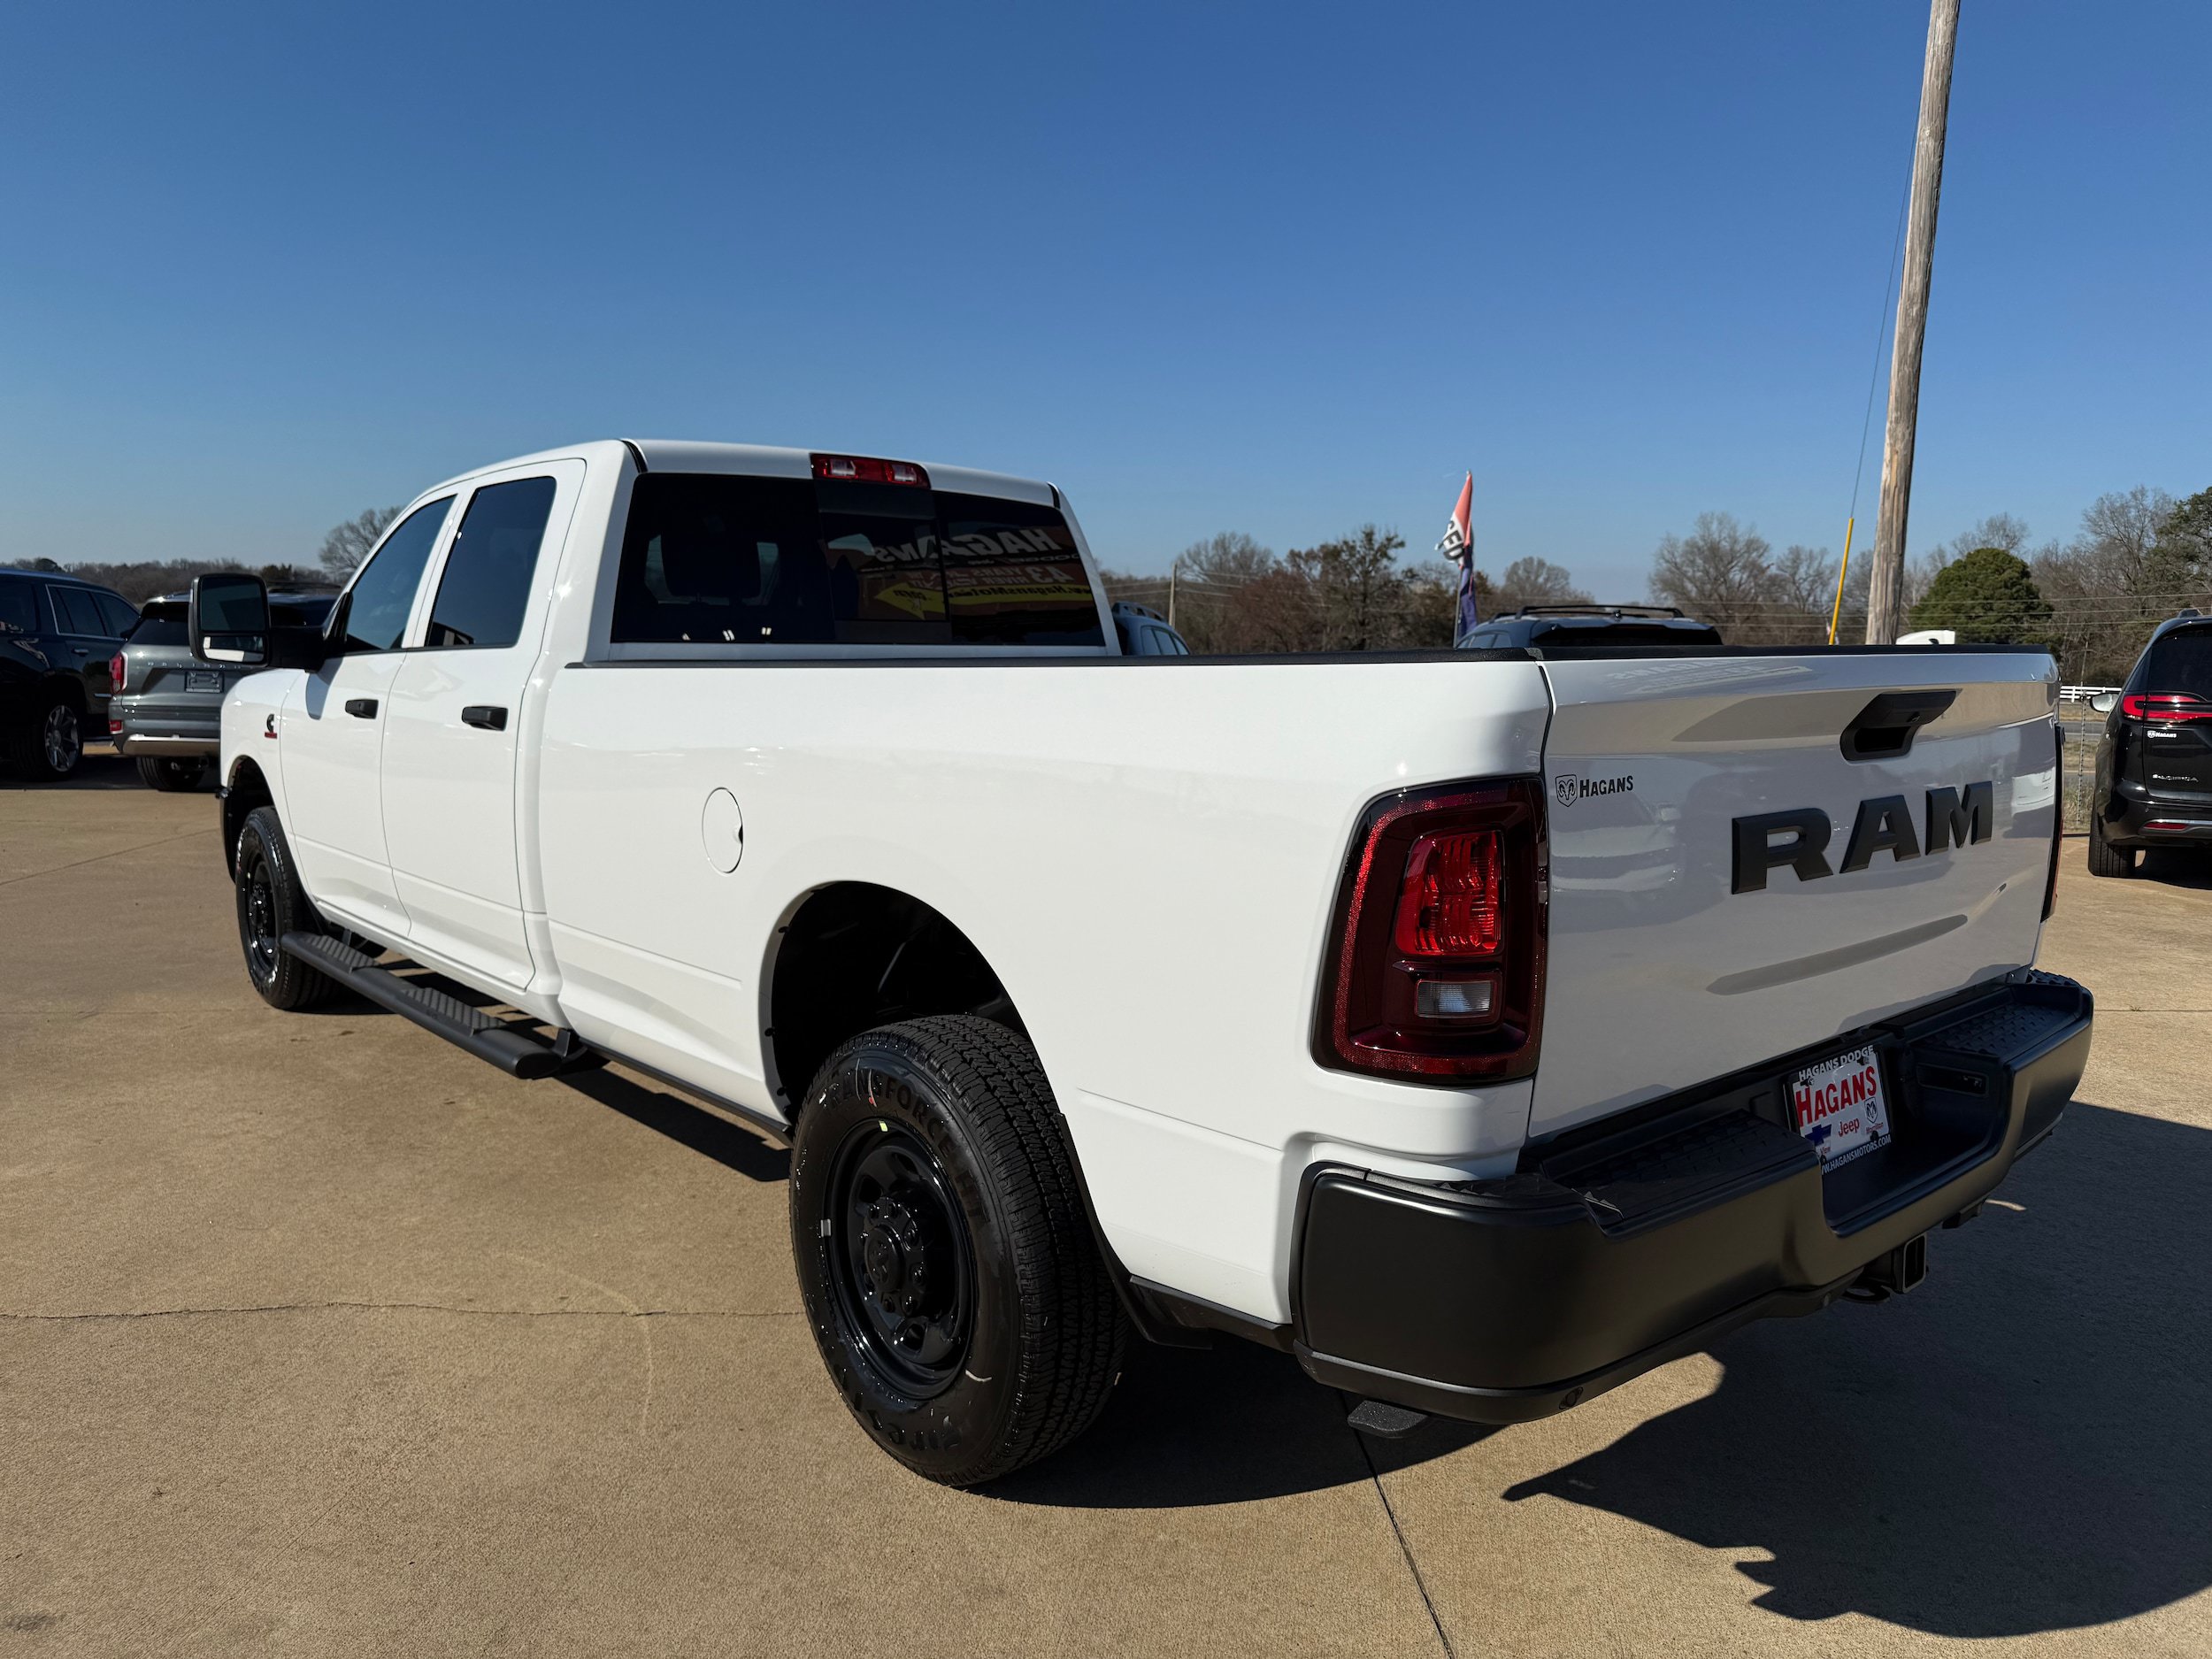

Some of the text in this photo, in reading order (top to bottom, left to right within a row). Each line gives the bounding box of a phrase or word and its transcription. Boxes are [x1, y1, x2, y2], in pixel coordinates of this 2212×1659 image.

[1579, 775, 1633, 798] HAGANS
[1732, 780, 1993, 895] RAM
[1799, 1045, 1874, 1082] HAGANS DODGE
[1795, 1066, 1878, 1127] HAGANS
[1839, 1118, 1860, 1138] Jeep
[1822, 1134, 1892, 1175] W.HAGANSMOTORS.COM
